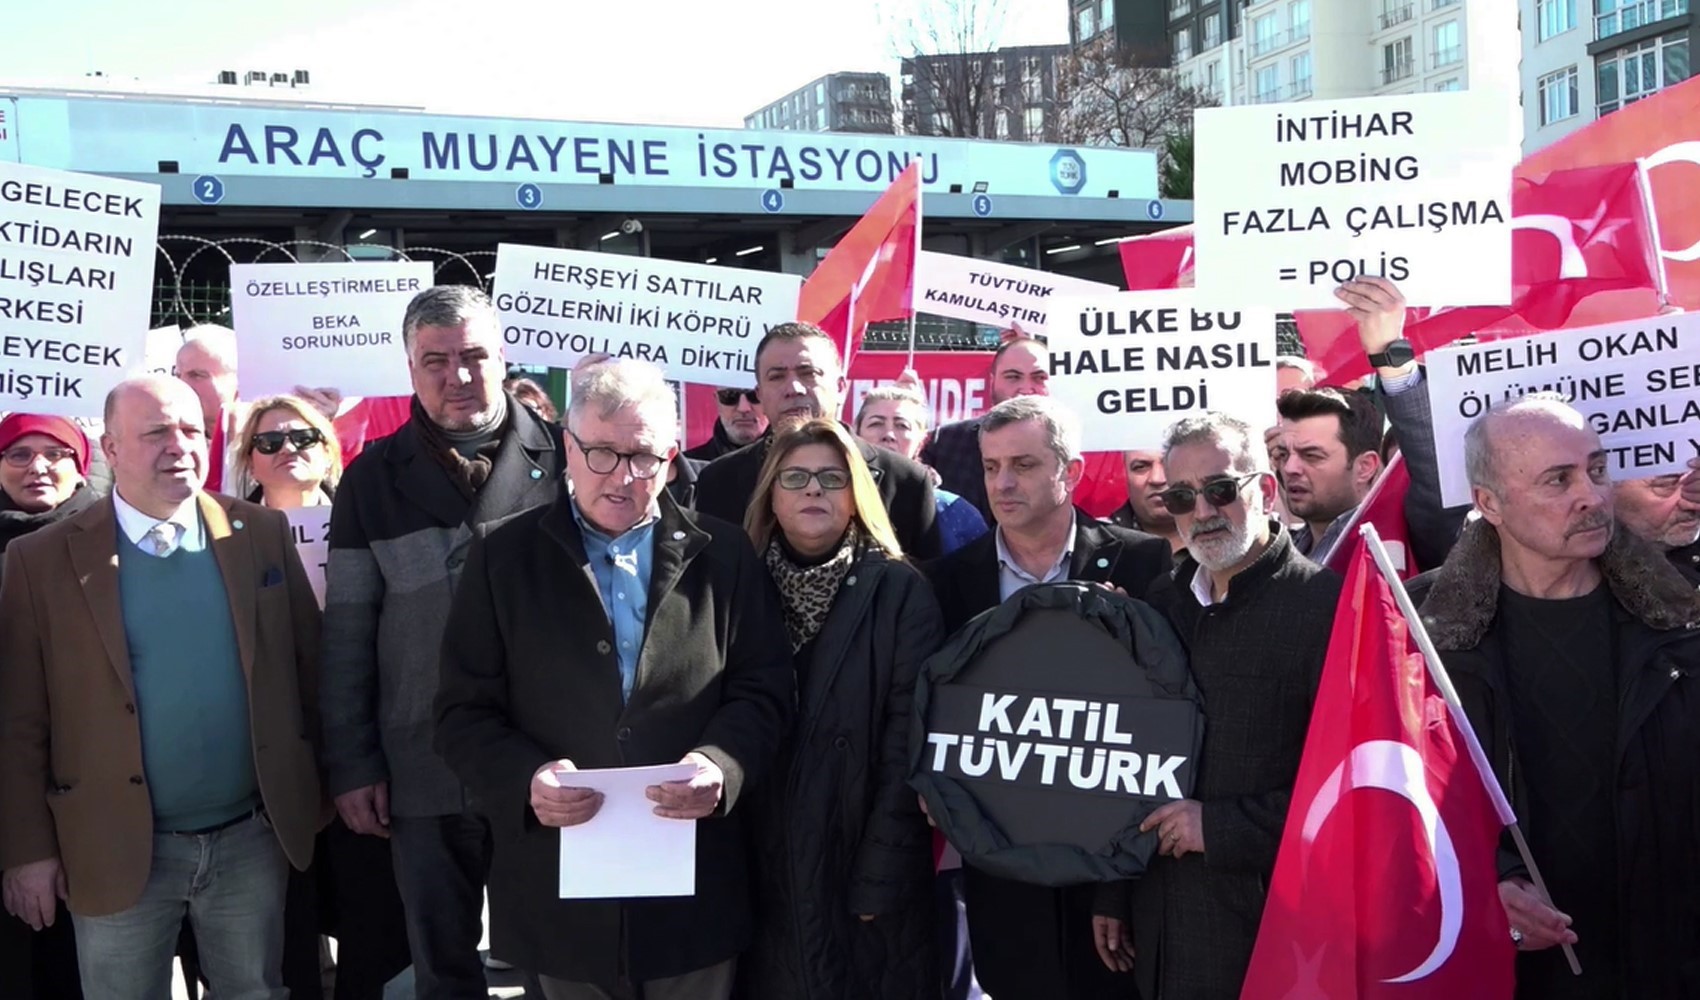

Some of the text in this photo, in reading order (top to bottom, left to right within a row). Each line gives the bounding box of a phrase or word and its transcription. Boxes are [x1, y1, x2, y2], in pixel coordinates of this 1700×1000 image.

[1276, 110, 1414, 142] İNTİHAR
[218, 123, 938, 184] ARAÇ MUAYENE İSTASYONU
[1280, 152, 1419, 187] MOBİNG
[1, 181, 143, 218] GELECEK
[204, 182, 216, 198] 2
[525, 189, 536, 204] 3
[768, 193, 779, 208] 4
[979, 198, 987, 212] 5
[1152, 203, 1159, 216] 6
[1223, 199, 1504, 237] FAZLA ÇALIŞMA
[0, 258, 115, 291] LIŞLARI
[533, 261, 762, 305] HERŞEYİ SATTILAR
[1309, 251, 1410, 285] POLİS
[246, 277, 420, 297] ÖZELLEŞTİRMELER
[969, 272, 1054, 298] TÜVTÜRK
[313, 315, 360, 330] BEKA
[496, 293, 622, 325] GÖZLERİNİ
[629, 308, 660, 328] İKİ
[667, 310, 751, 338] KÖPRÜ
[924, 288, 1047, 324] KAMULAŞTIRI
[1079, 307, 1179, 337] ÜLKE
[0, 335, 122, 367] EYECEK
[282, 331, 392, 351] SORUNUDUR
[503, 325, 669, 363] OTOYOLLARA
[1457, 326, 1678, 376] MELİH OKAN
[1050, 342, 1271, 376] HALE NASIL
[0, 368, 83, 400] İŞTİK
[1096, 378, 1208, 414] GELDİ
[978, 692, 1133, 744] KATİL
[927, 732, 1188, 799] TÜVTÜRK
